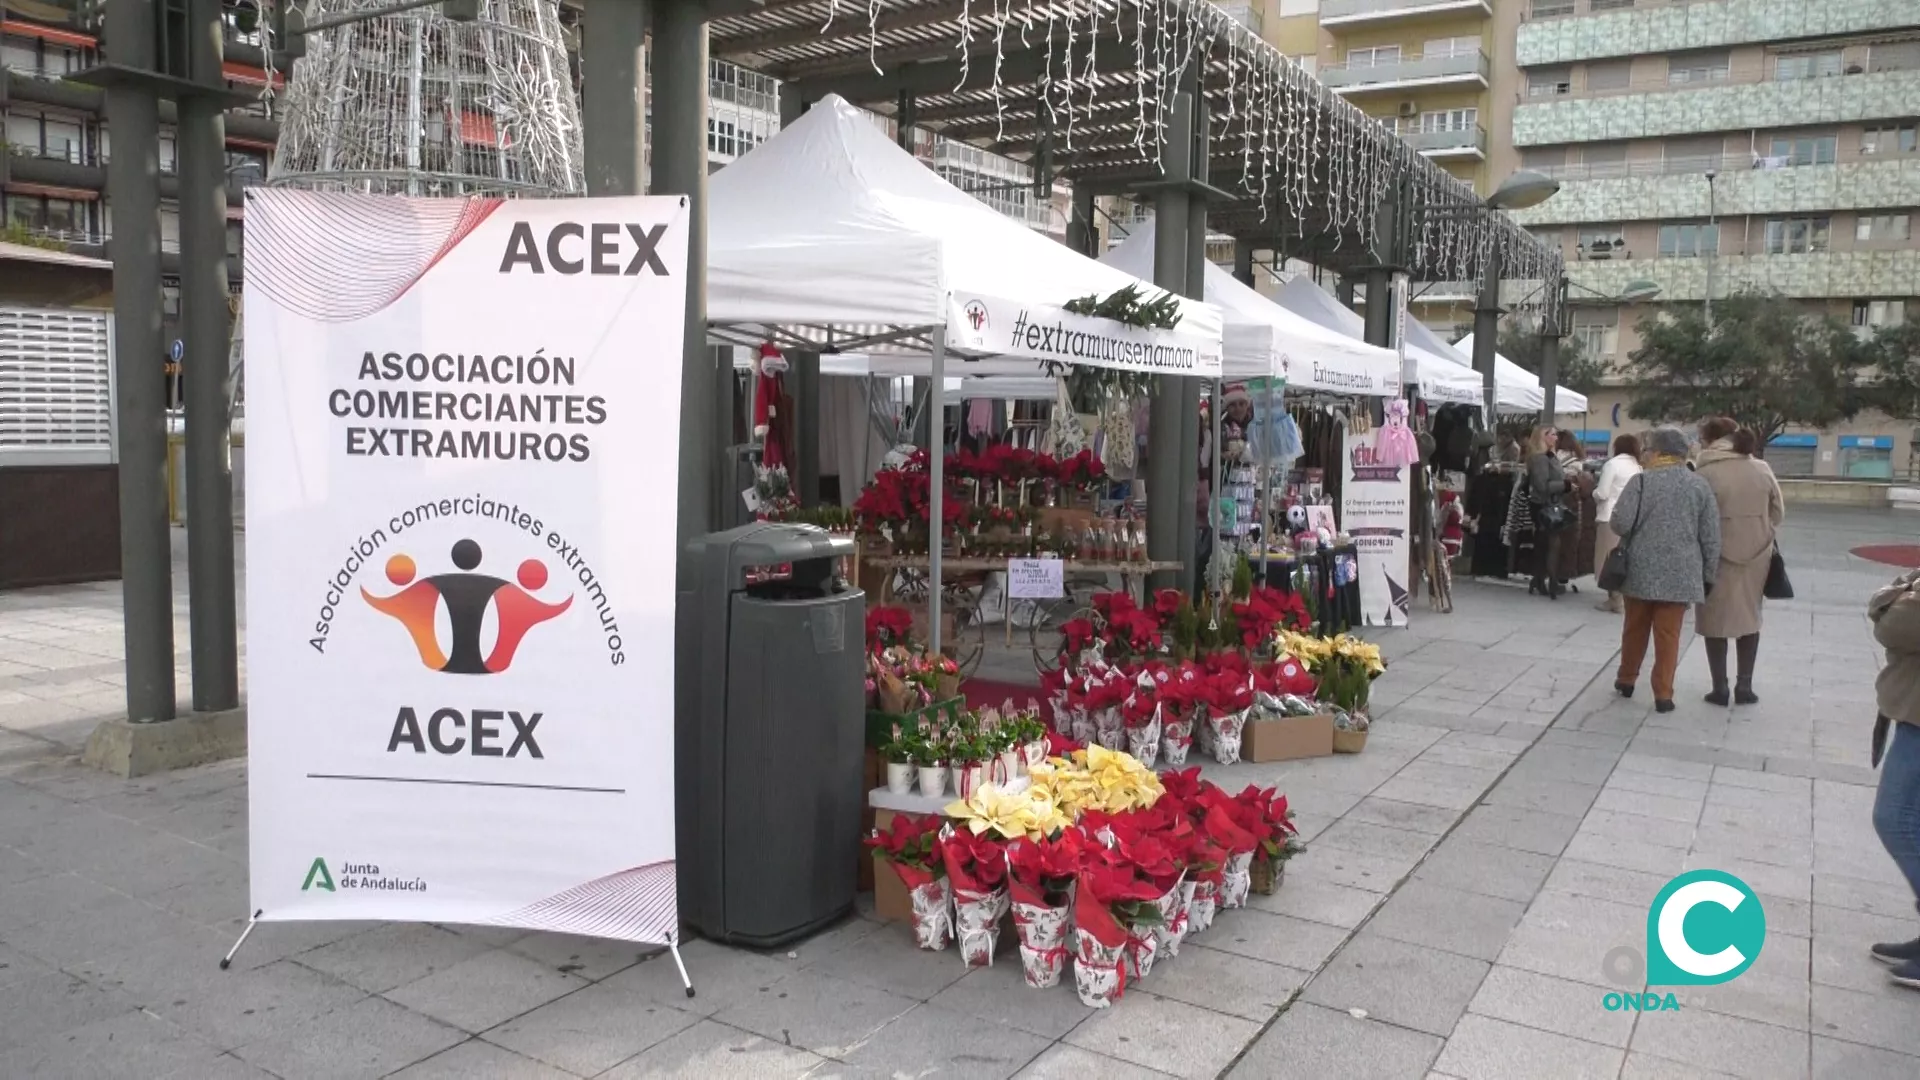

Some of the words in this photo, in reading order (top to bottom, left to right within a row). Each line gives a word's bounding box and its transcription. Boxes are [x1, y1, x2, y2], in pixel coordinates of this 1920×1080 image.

[499, 222, 669, 276] ACEX
[1012, 309, 1193, 369] #extramurosenamora
[358, 348, 575, 385] ASOCIACIÓN
[1313, 361, 1373, 390] Extramureando
[329, 389, 607, 425] COMERCIANTES
[346, 427, 591, 462] EXTRAMUROS
[309, 528, 387, 654] Asociación
[388, 493, 544, 536] comerciantes
[546, 531, 625, 666] extramuros
[387, 706, 545, 759] ACEX
[341, 862, 380, 875] Junta
[341, 876, 358, 888] de
[360, 877, 427, 892] Andalucía
